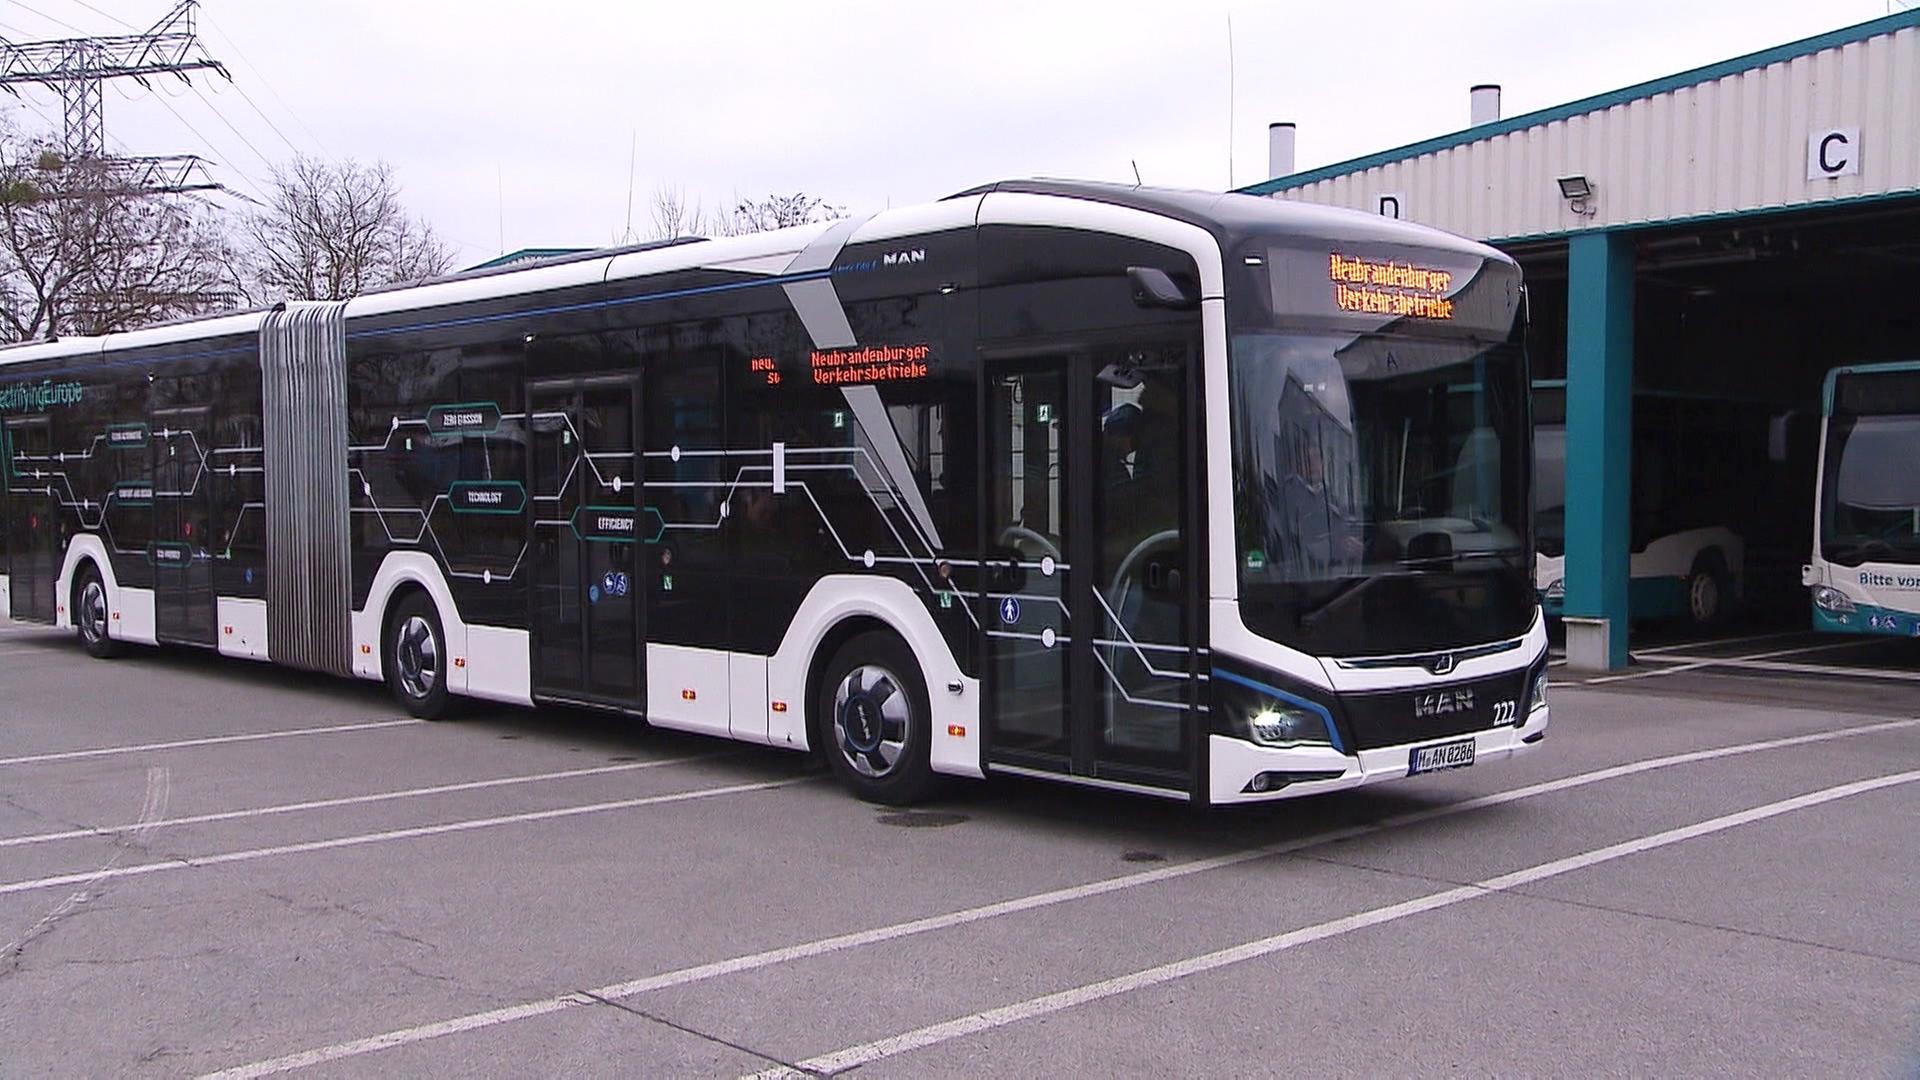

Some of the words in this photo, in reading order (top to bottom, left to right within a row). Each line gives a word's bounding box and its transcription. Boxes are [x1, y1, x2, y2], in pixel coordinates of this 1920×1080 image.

[1820, 133, 1848, 172] C
[883, 250, 925, 265] MAN
[1330, 253, 1451, 292] Neubrandenburger
[1337, 284, 1451, 317] Verkehrsbetriebe
[811, 345, 929, 366] Neubrandenburger
[814, 361, 927, 383] Verkehrsbetriebe
[598, 517, 634, 531] EFFICIENCY
[1860, 572, 1893, 586] Bitte
[1415, 688, 1474, 717] MAN
[1493, 701, 1516, 726] 222
[1446, 744, 1473, 763] 8286
